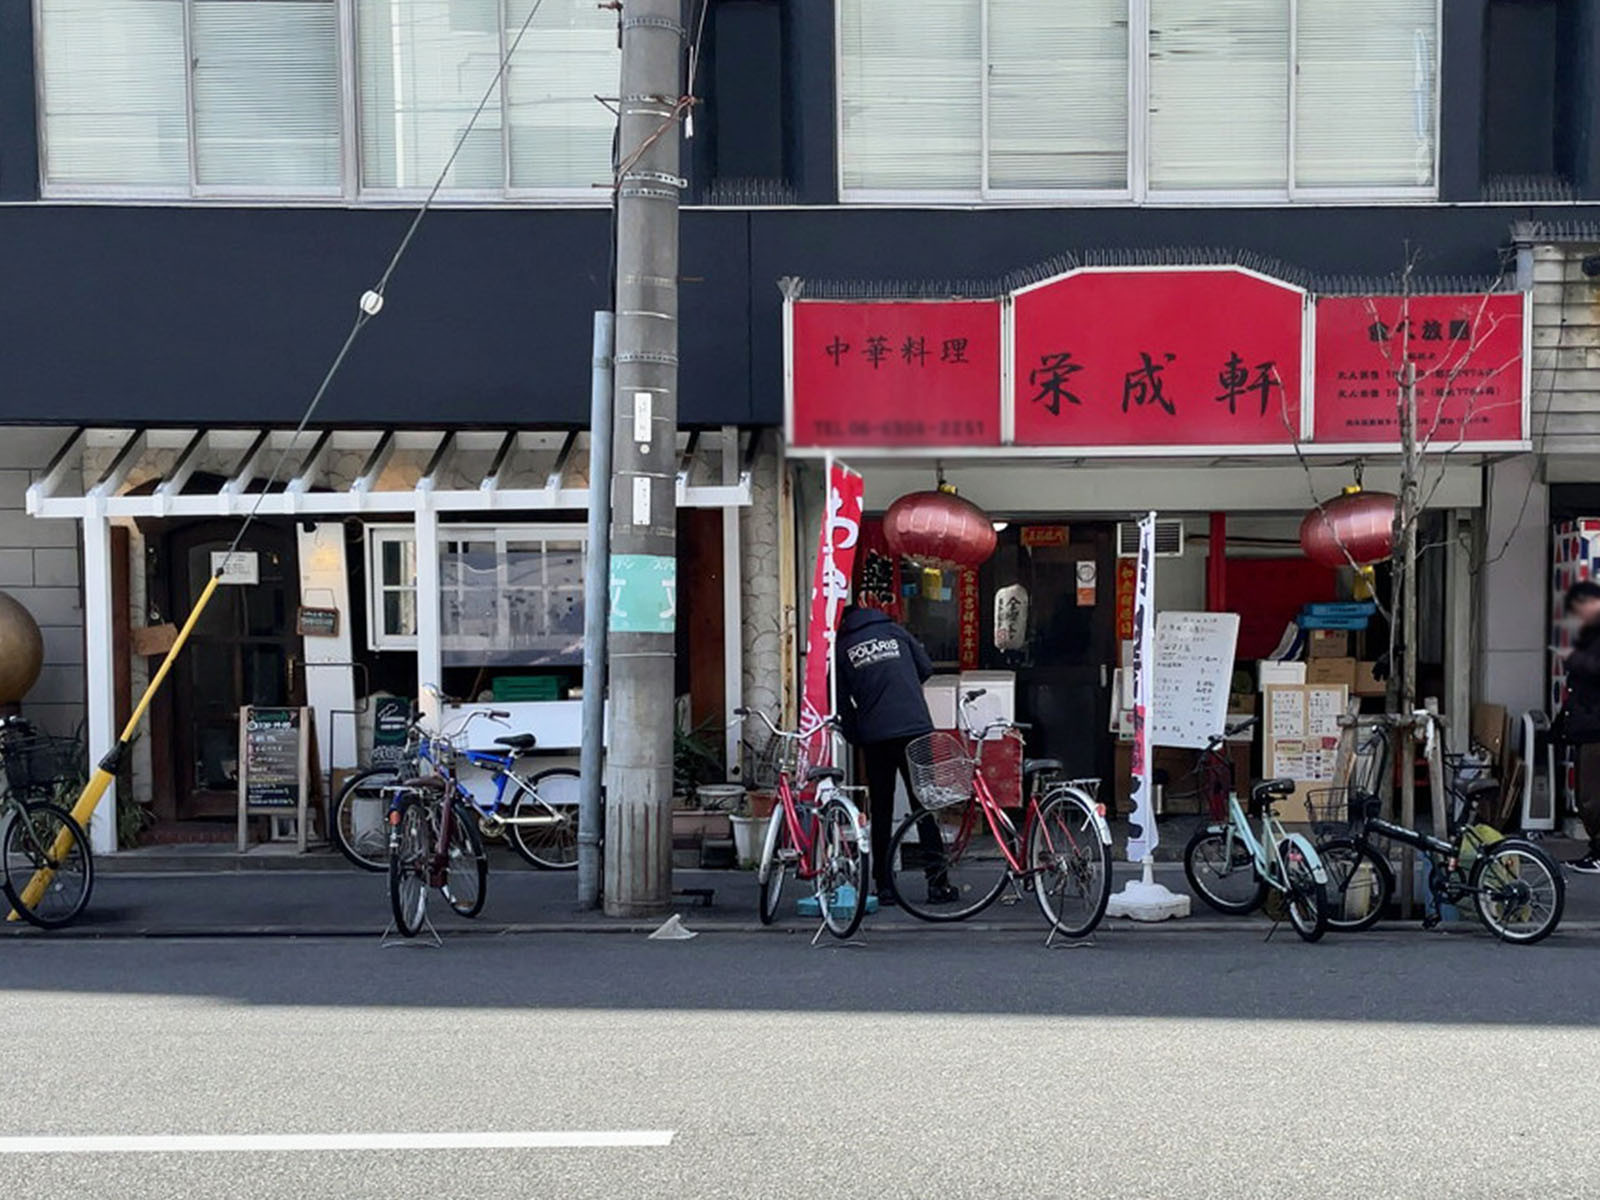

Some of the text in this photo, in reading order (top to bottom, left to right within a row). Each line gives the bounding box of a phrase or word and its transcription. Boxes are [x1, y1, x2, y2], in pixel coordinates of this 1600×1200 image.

[825, 335, 970, 369] 中華料理
[1029, 350, 1280, 417] 栄成軒
[848, 639, 899, 662] POLARIS
